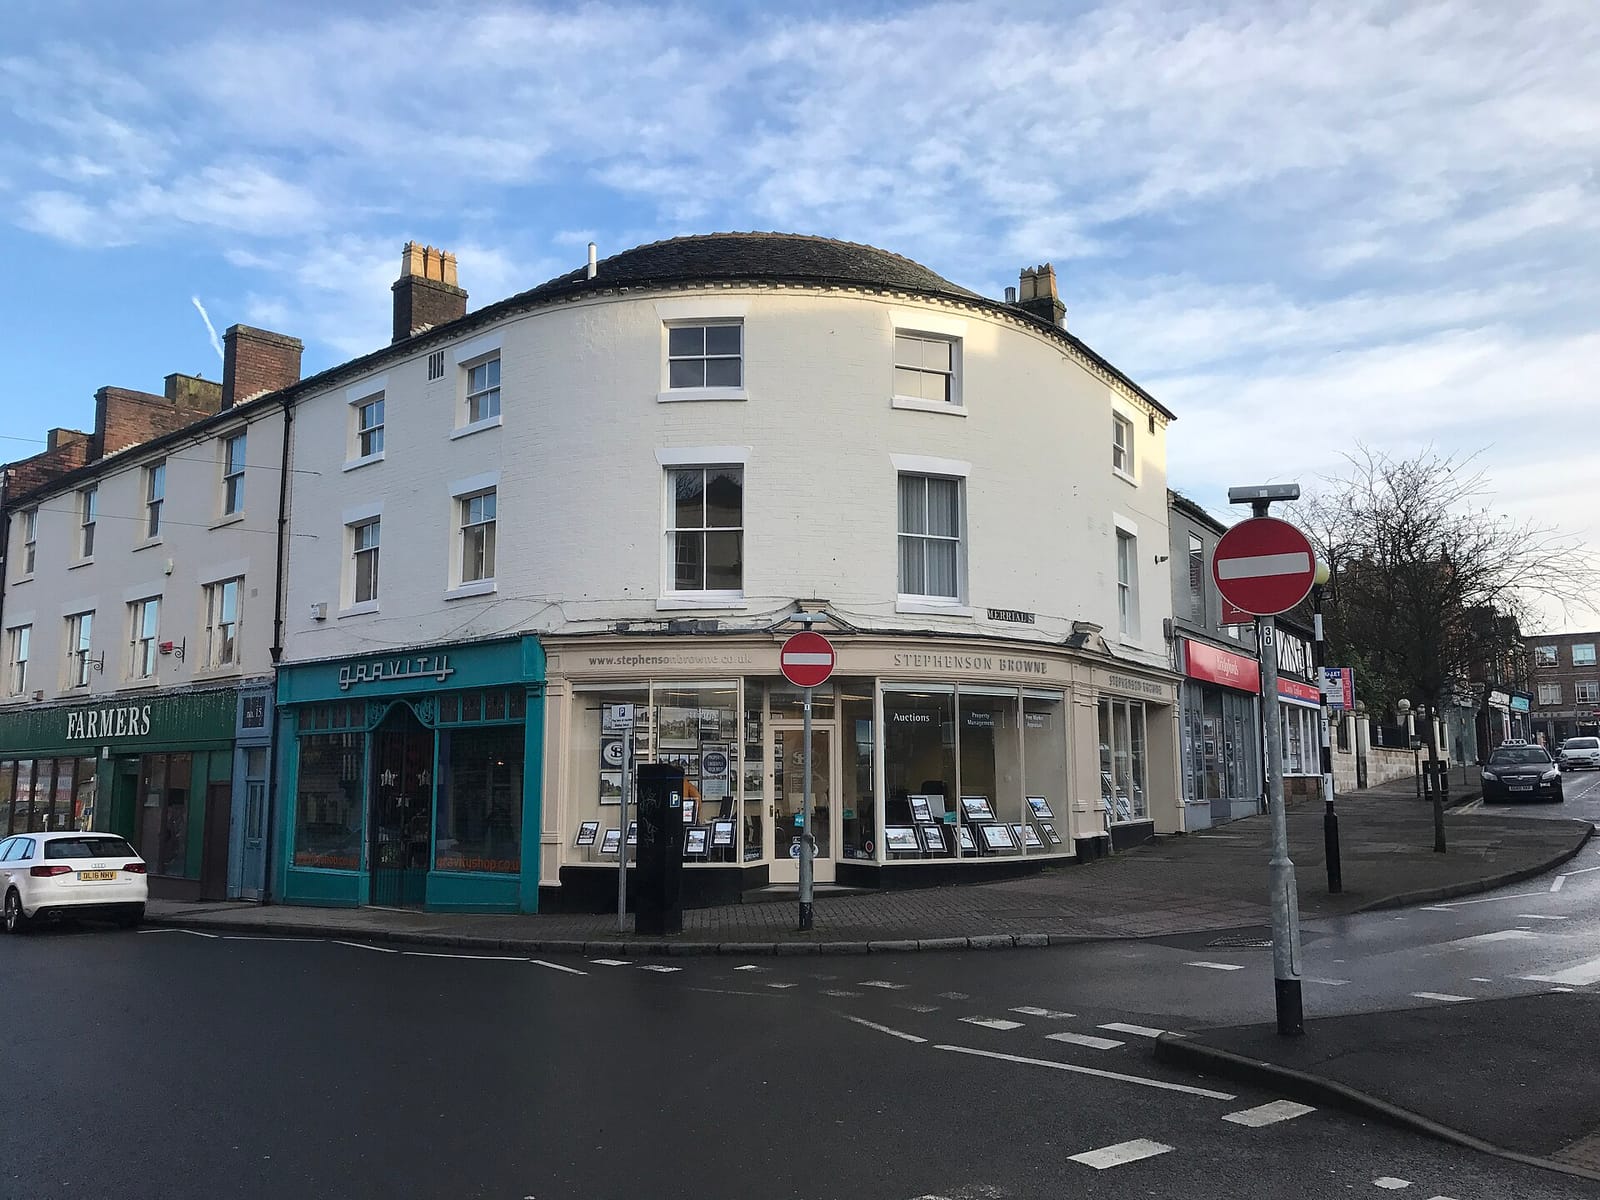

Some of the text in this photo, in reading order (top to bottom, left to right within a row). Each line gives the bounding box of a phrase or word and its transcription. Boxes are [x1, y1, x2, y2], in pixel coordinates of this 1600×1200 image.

[588, 653, 752, 667] www.stephensonbrowne.co.uk
[894, 653, 1048, 675] STEPHENSON BROWNE
[66, 705, 151, 740] FARMERS
[893, 712, 930, 723] Auctions
